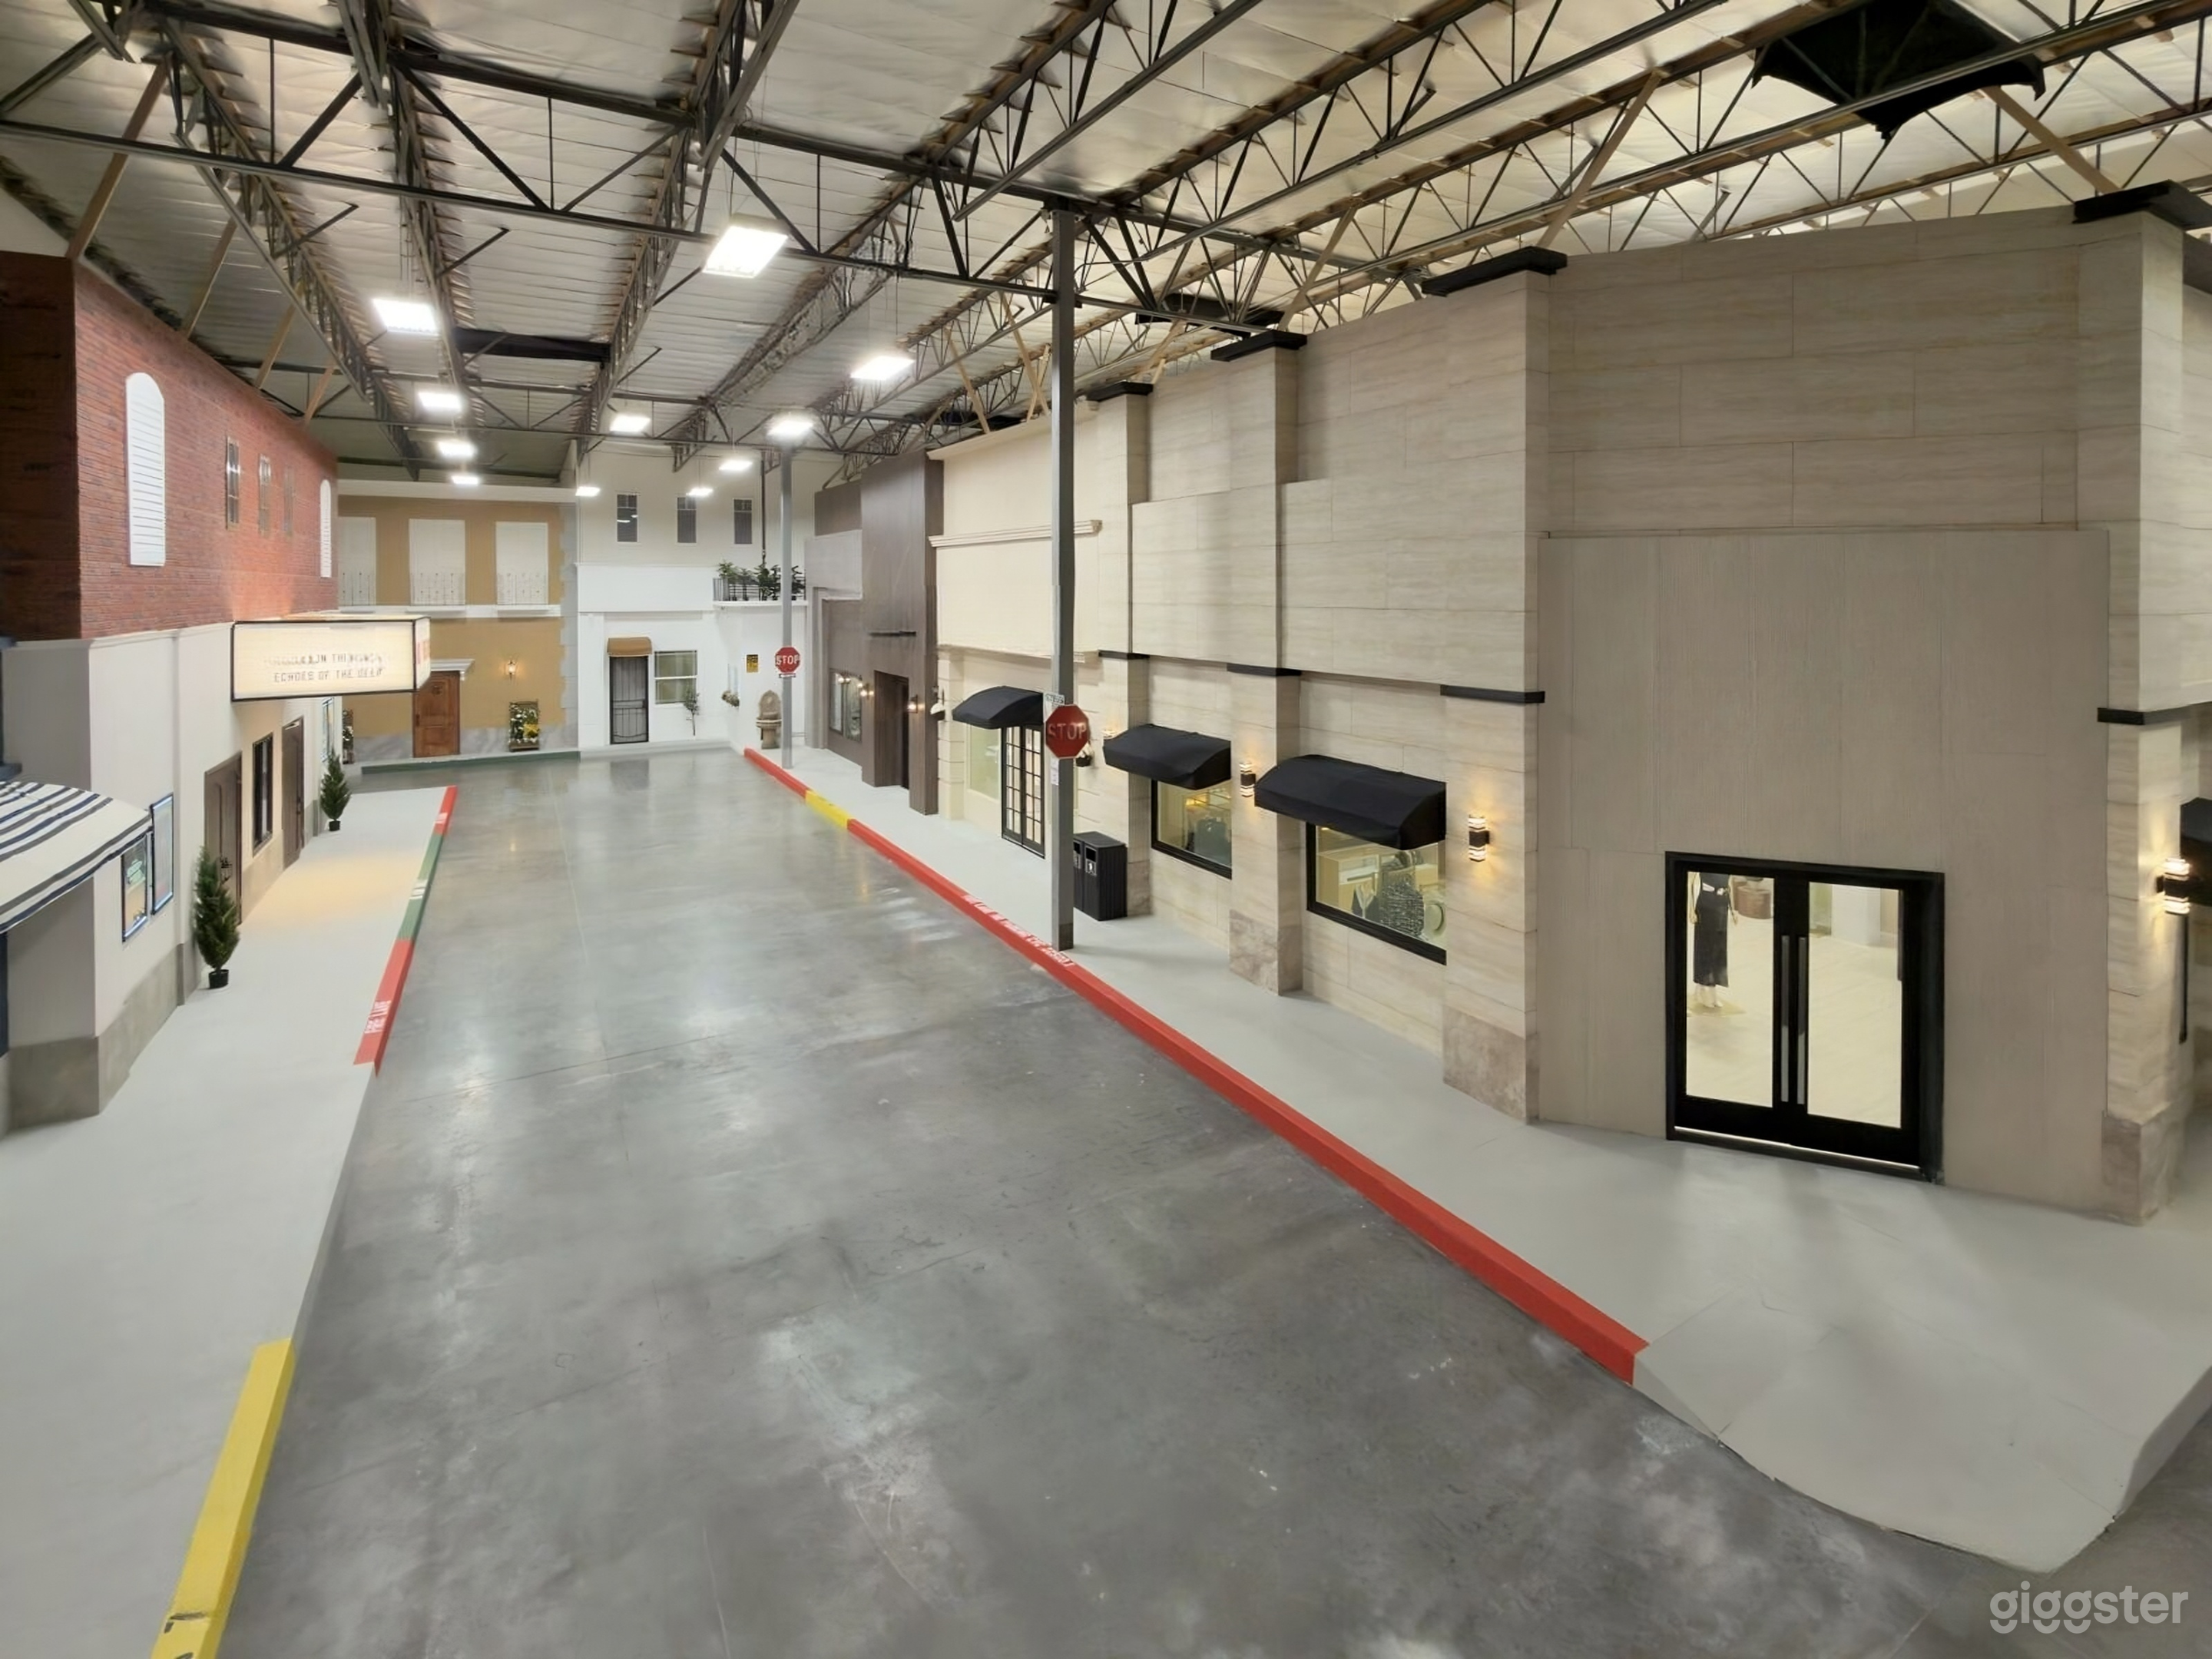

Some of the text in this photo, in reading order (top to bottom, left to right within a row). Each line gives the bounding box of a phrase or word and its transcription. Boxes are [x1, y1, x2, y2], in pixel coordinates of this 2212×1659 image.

[776, 654, 800, 666] STOP
[273, 671, 314, 683] ECHOES
[318, 670, 329, 680] OF
[336, 669, 353, 679] THE
[1048, 723, 1087, 740] STOP
